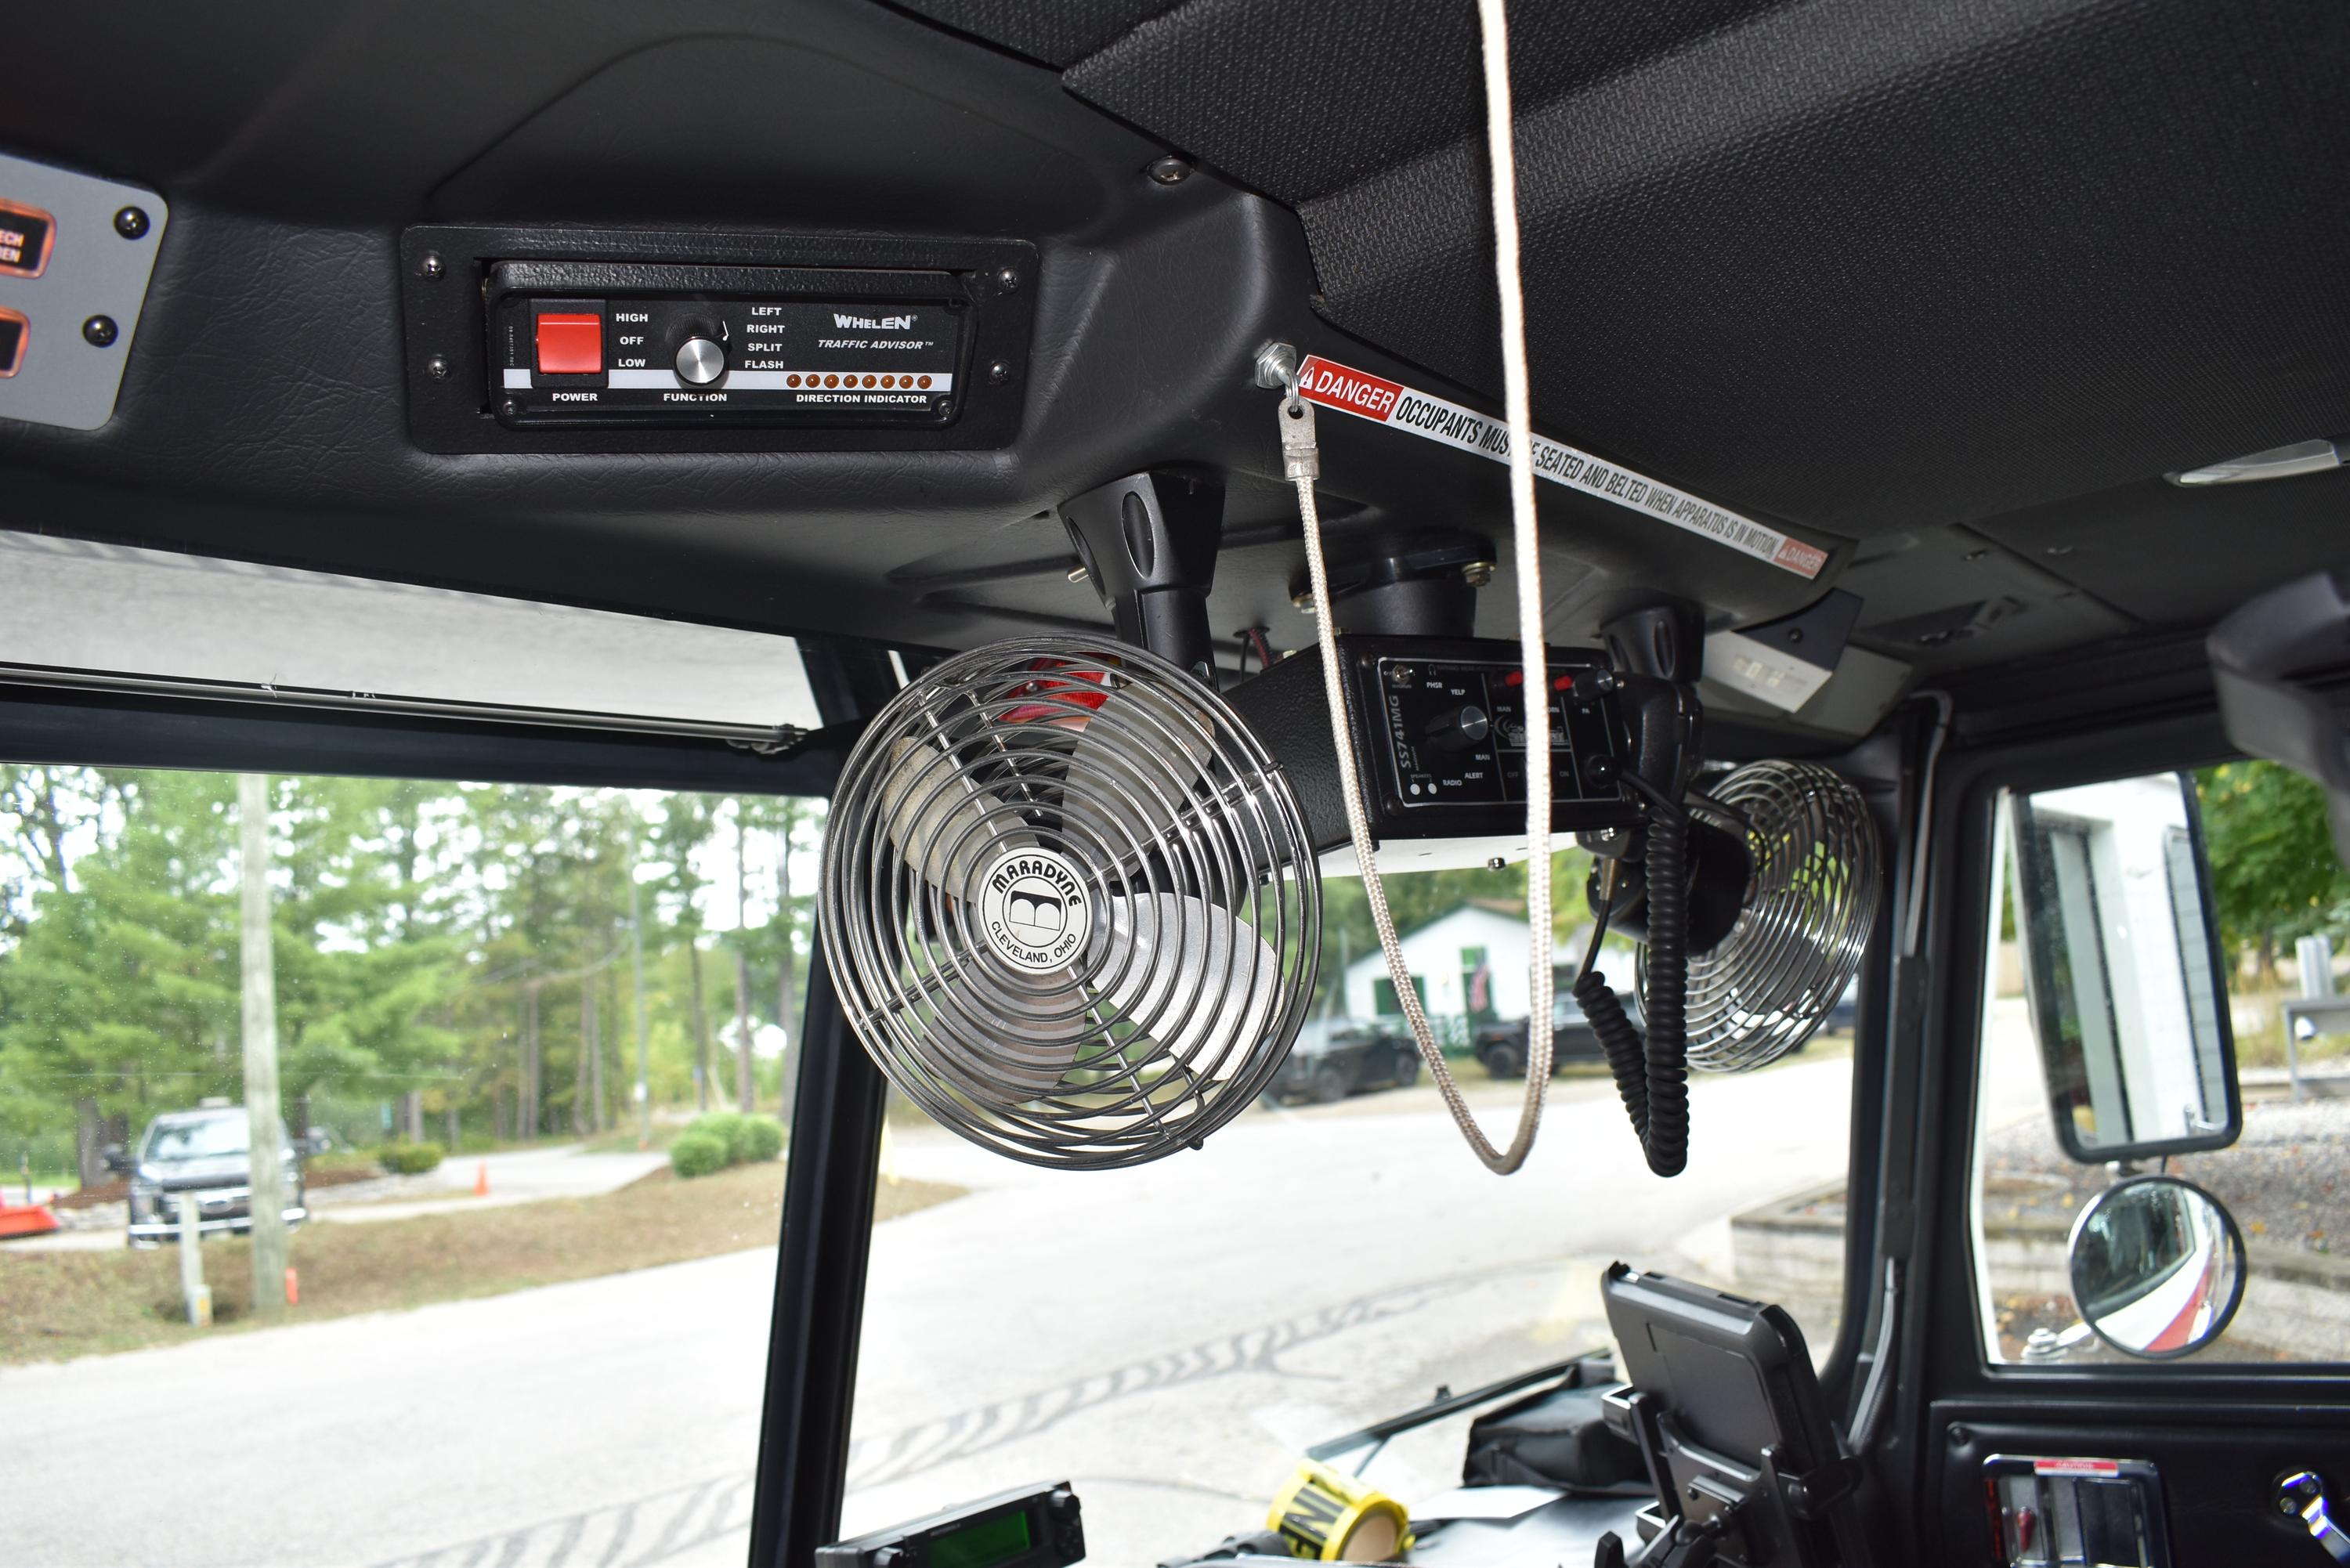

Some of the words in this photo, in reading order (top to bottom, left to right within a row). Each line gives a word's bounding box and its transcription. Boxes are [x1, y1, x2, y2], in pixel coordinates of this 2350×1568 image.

[751, 307, 782, 316] LEFT
[616, 313, 649, 322] HIGH
[747, 325, 785, 334] RIGHT
[620, 337, 644, 345] OFF
[818, 339, 868, 349] TRAFFIC
[747, 343, 783, 352] SPLIT
[618, 359, 646, 367] LOW
[745, 360, 784, 369] FLASH
[1314, 370, 1395, 414] DANGER
[552, 393, 598, 402] POWER
[663, 393, 728, 402] FUNCTION
[796, 395, 860, 403] DIRECTION
[864, 395, 927, 404] INDICATOR
[1396, 396, 1482, 444] OCCUPANTS
[1479, 425, 1511, 457] MUS
[1535, 446, 1584, 479] SEATED
[1580, 463, 1609, 489] AND
[1605, 471, 1647, 504] BELTED
[1644, 486, 1677, 515] WHEN
[1674, 499, 1729, 534] APPARATUS
[1725, 519, 1738, 539] IS
[1733, 525, 1748, 541] IN
[1389, 695, 1412, 769] SS741MG
[992, 860, 1082, 907] MARADYNE
[991, 921, 1052, 963] CLEVELAND,
[1054, 933, 1076, 958] OHIO
